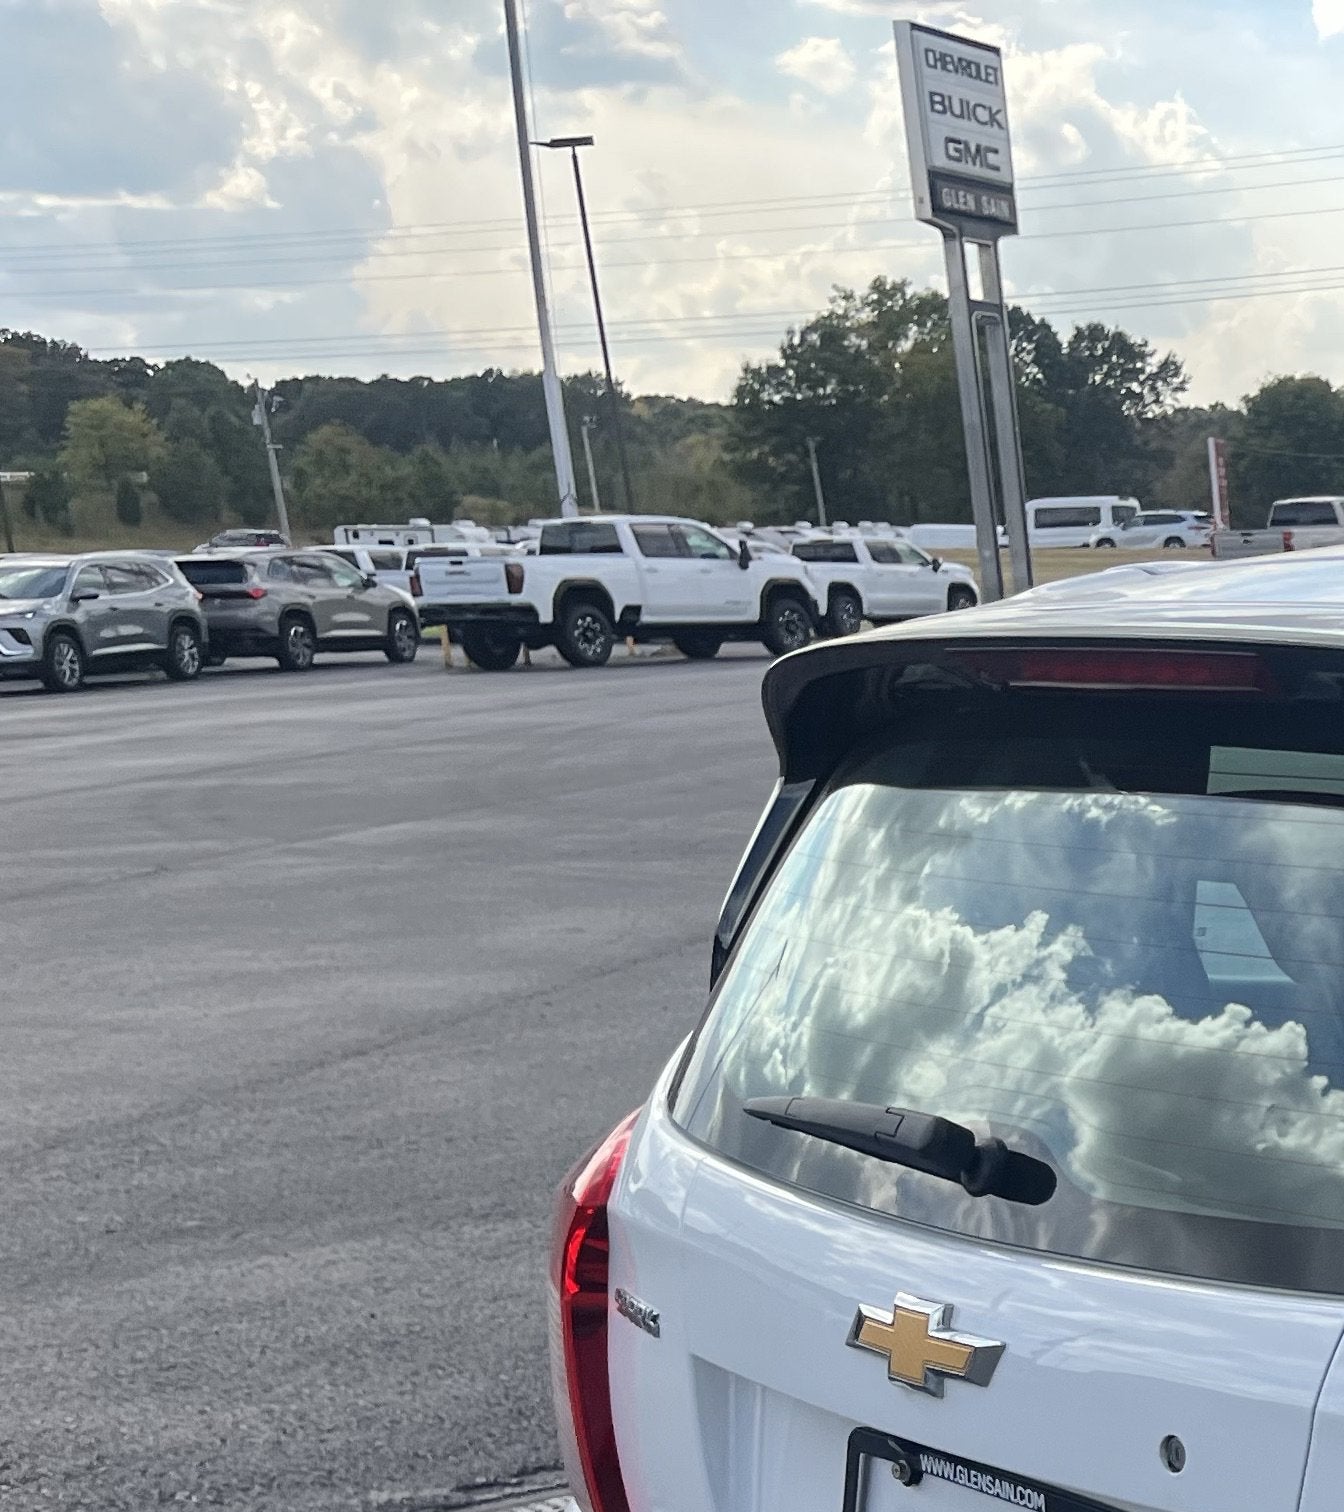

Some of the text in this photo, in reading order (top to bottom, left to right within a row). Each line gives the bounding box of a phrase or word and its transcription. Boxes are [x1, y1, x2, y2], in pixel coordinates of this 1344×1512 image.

[924, 48, 999, 86] CHEVROLET
[928, 90, 1005, 130] BUICK
[944, 136, 1001, 172] GMC
[941, 187, 976, 212] GLEN
[919, 1453, 1046, 1512] WWW.GLENSAIN.COM
